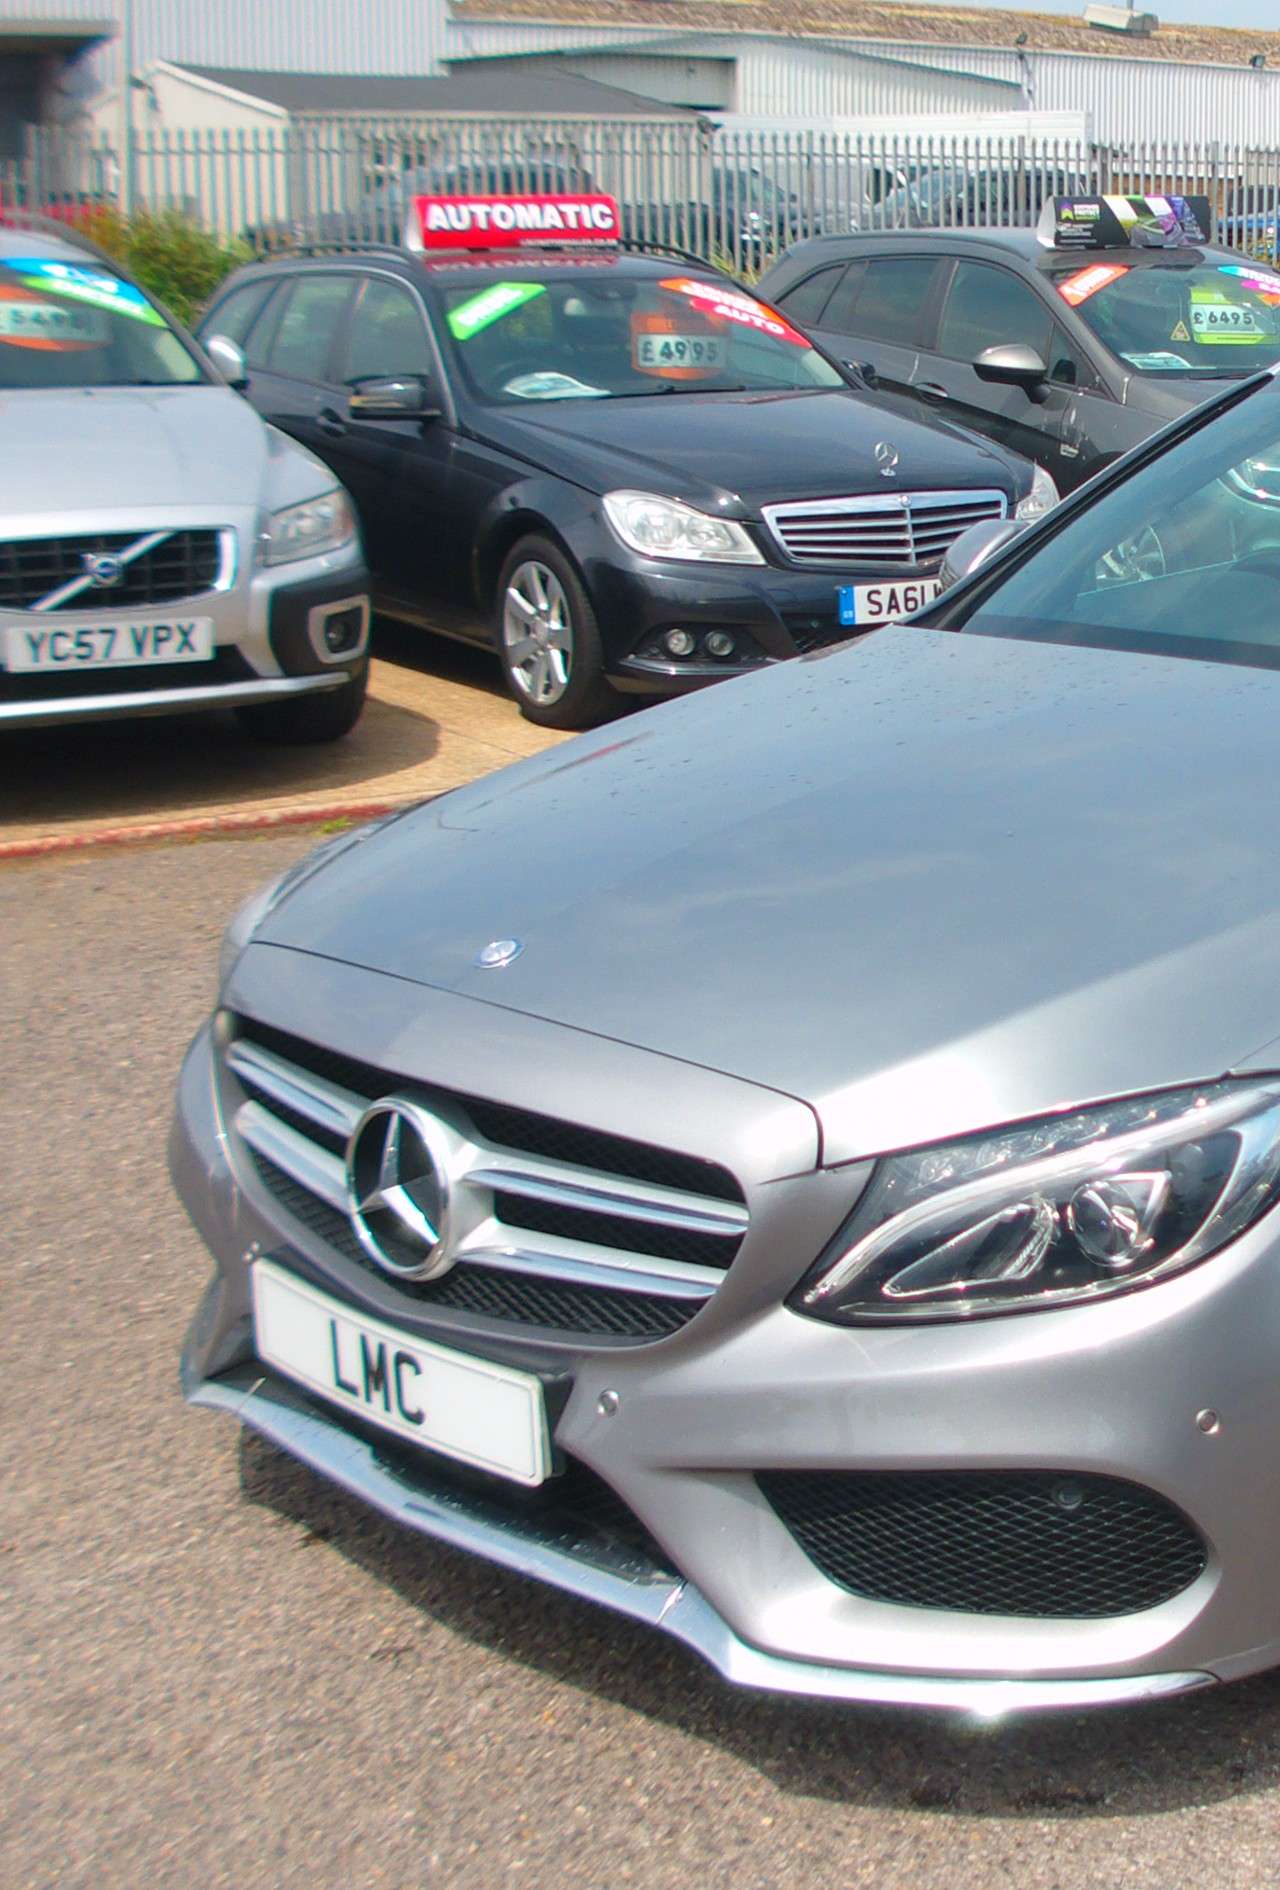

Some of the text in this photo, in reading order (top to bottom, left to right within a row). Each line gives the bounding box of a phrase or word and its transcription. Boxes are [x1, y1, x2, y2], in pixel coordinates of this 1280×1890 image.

[426, 203, 615, 231] AUTOMATIC
[714, 304, 785, 335] AUTO
[25, 622, 196, 664] YC57 VPX
[329, 1317, 426, 1426] LMC
